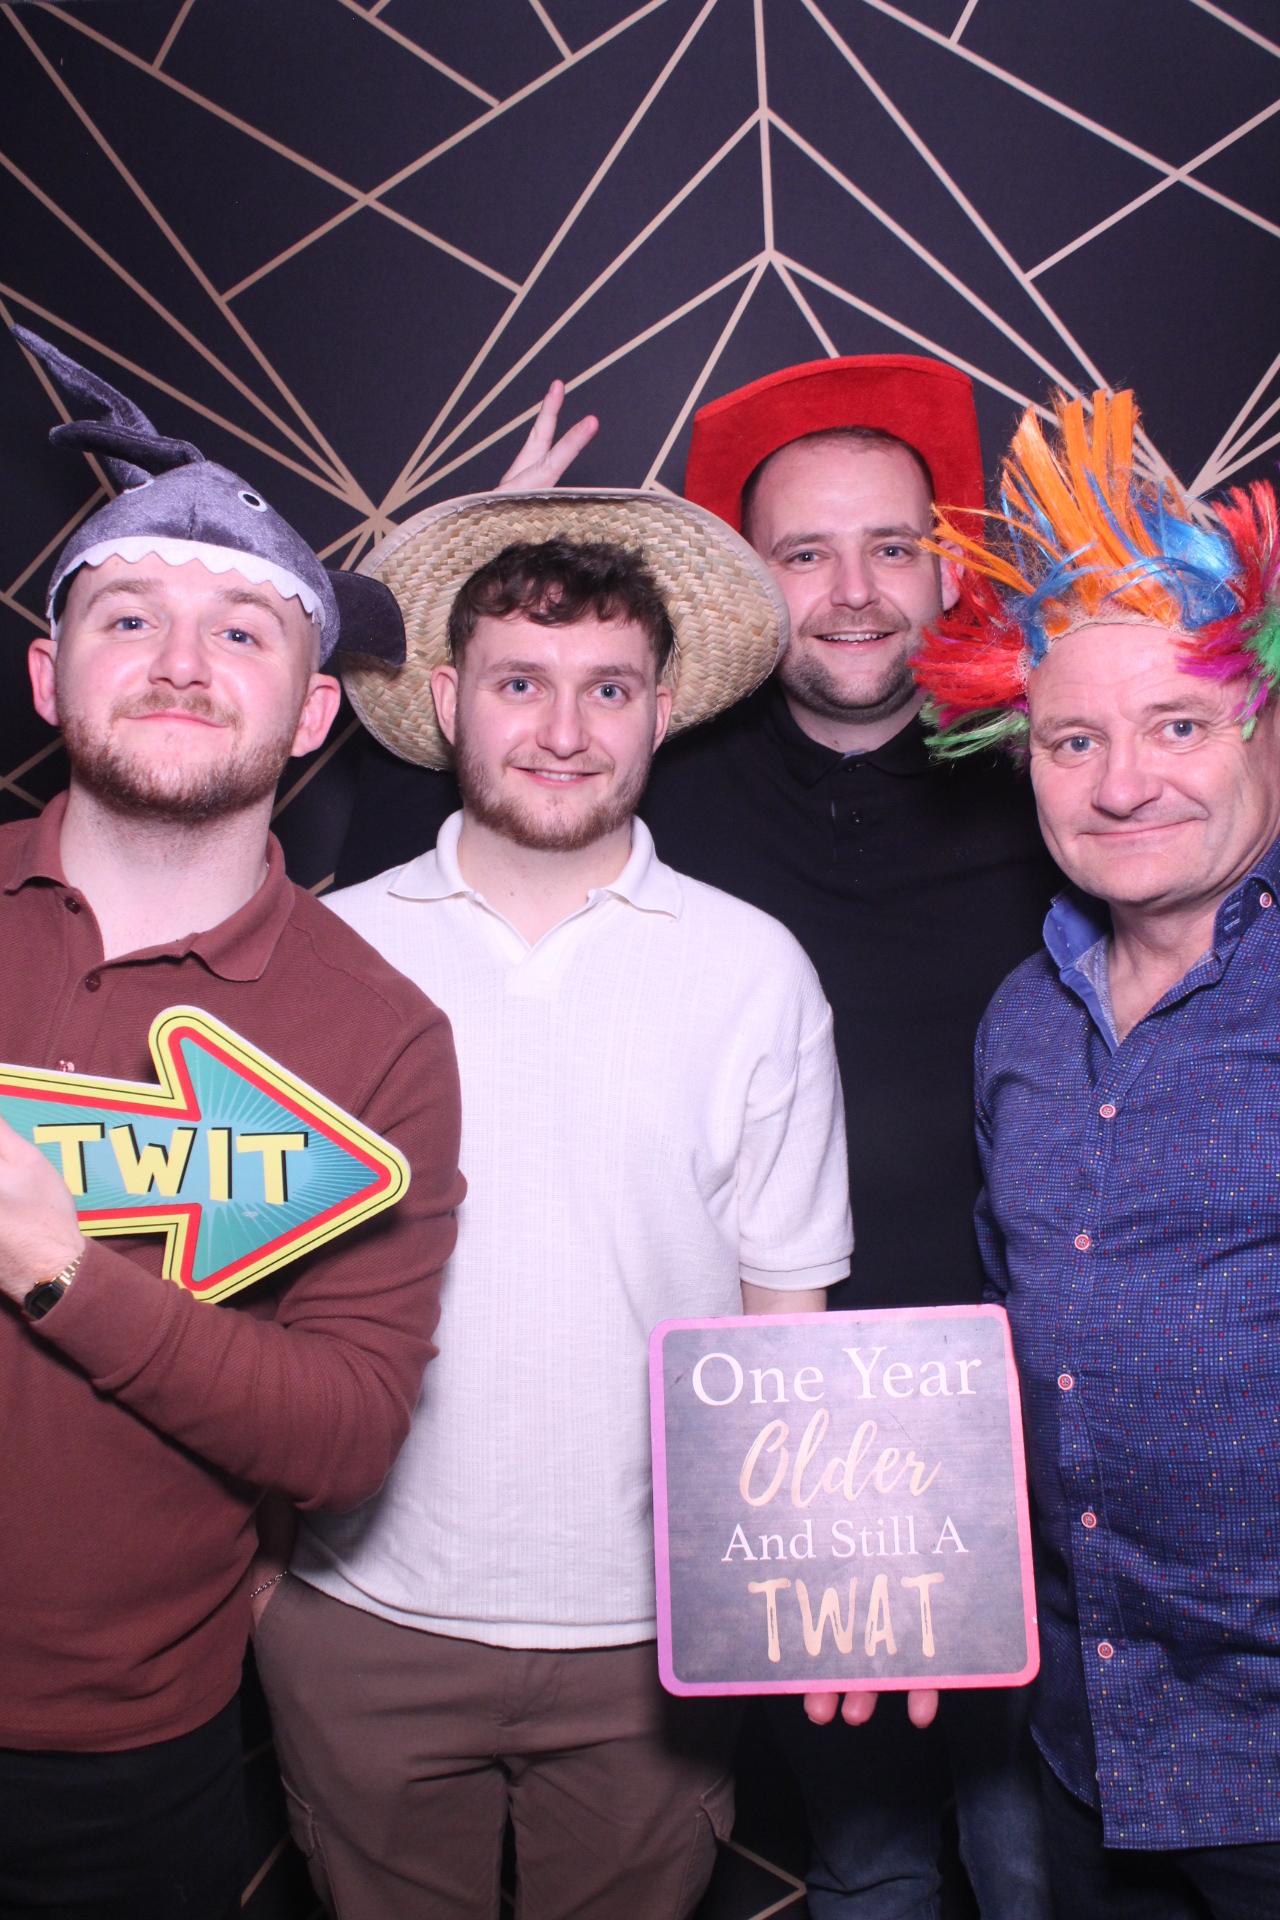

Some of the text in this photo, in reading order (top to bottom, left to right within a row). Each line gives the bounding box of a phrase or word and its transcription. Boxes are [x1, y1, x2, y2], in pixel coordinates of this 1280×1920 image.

[33, 1122, 309, 1206] TWIT
[692, 1346, 982, 1406] One Year
[739, 1408, 942, 1508] Older
[721, 1515, 969, 1562] And Still A
[748, 1572, 945, 1663] TWAT
